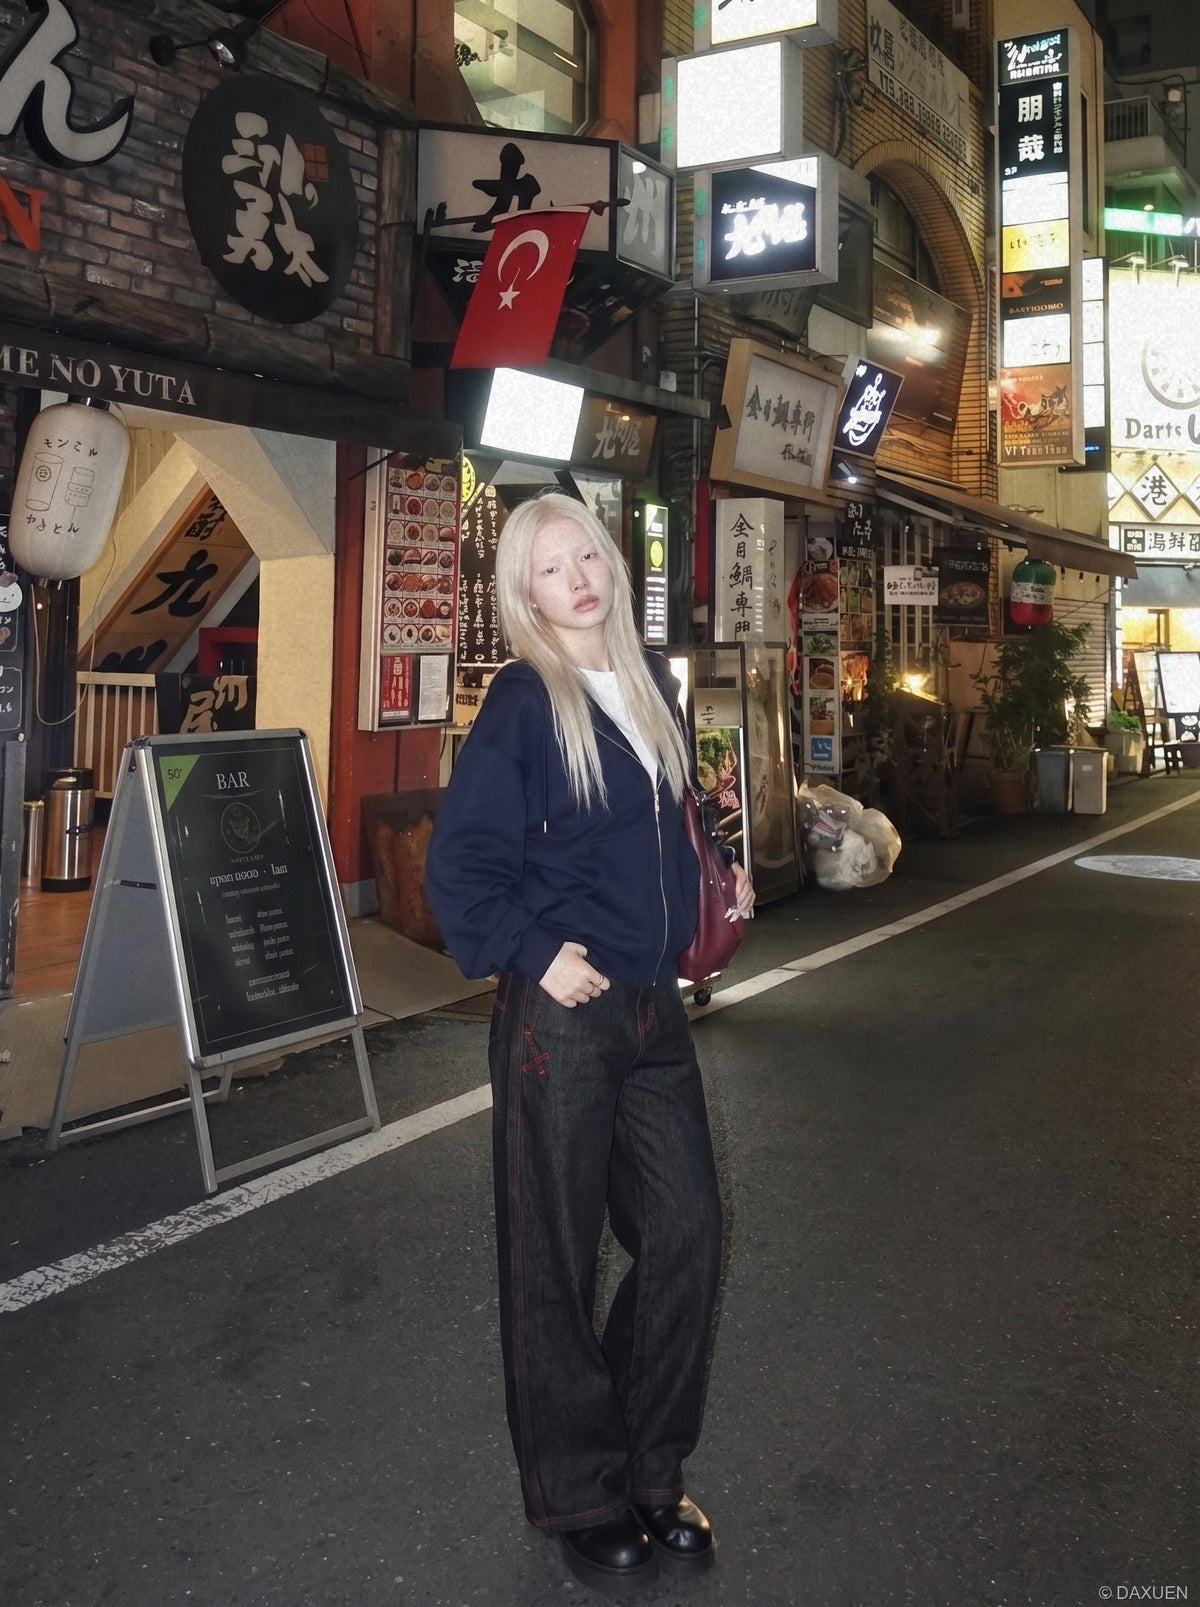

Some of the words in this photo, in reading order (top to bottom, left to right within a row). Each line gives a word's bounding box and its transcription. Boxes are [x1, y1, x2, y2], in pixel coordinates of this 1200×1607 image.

[50, 353, 101, 388] NO
[109, 364, 197, 406] YUTA
[1125, 417, 1182, 439] Darts
[1141, 474, 1168, 506] 港
[215, 771, 251, 790] BAR
